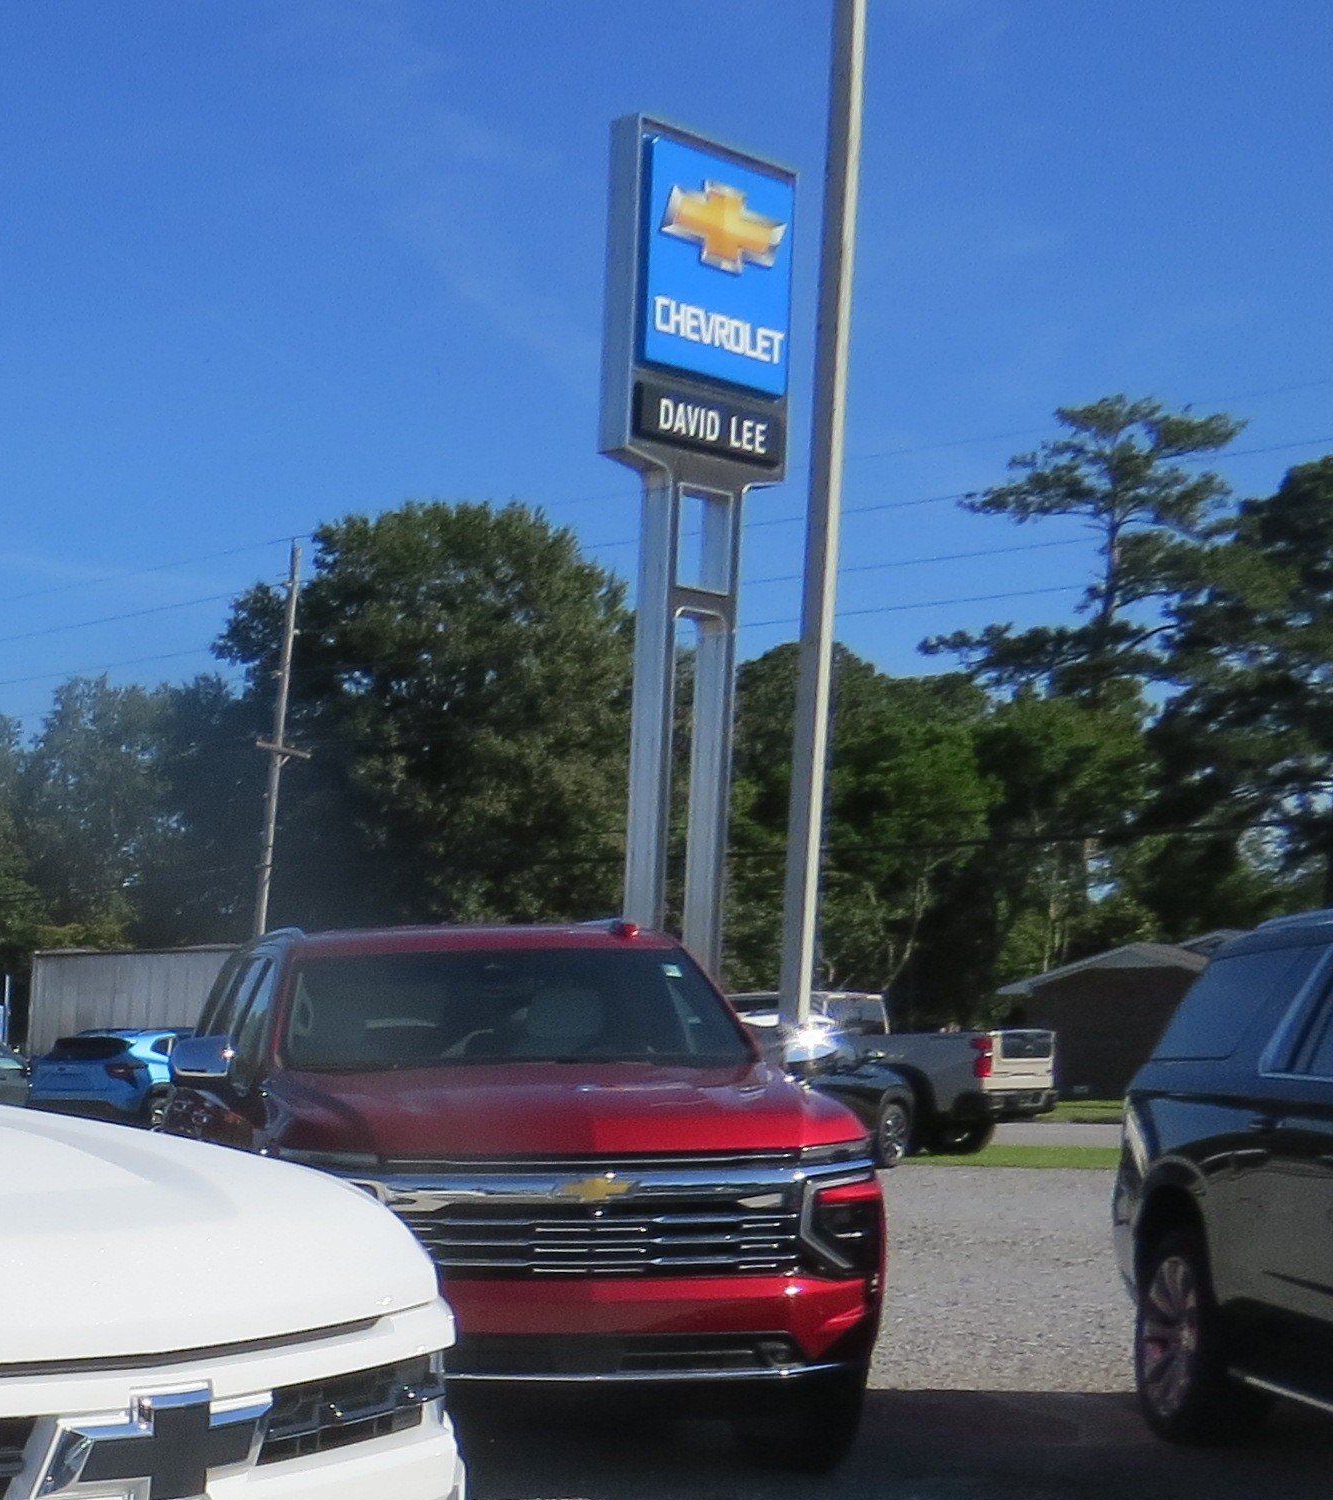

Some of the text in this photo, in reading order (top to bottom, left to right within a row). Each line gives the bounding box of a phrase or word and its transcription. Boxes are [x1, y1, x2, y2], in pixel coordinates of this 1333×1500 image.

[654, 296, 786, 365] CHEVROLET
[658, 398, 769, 454] DAVID LEE
